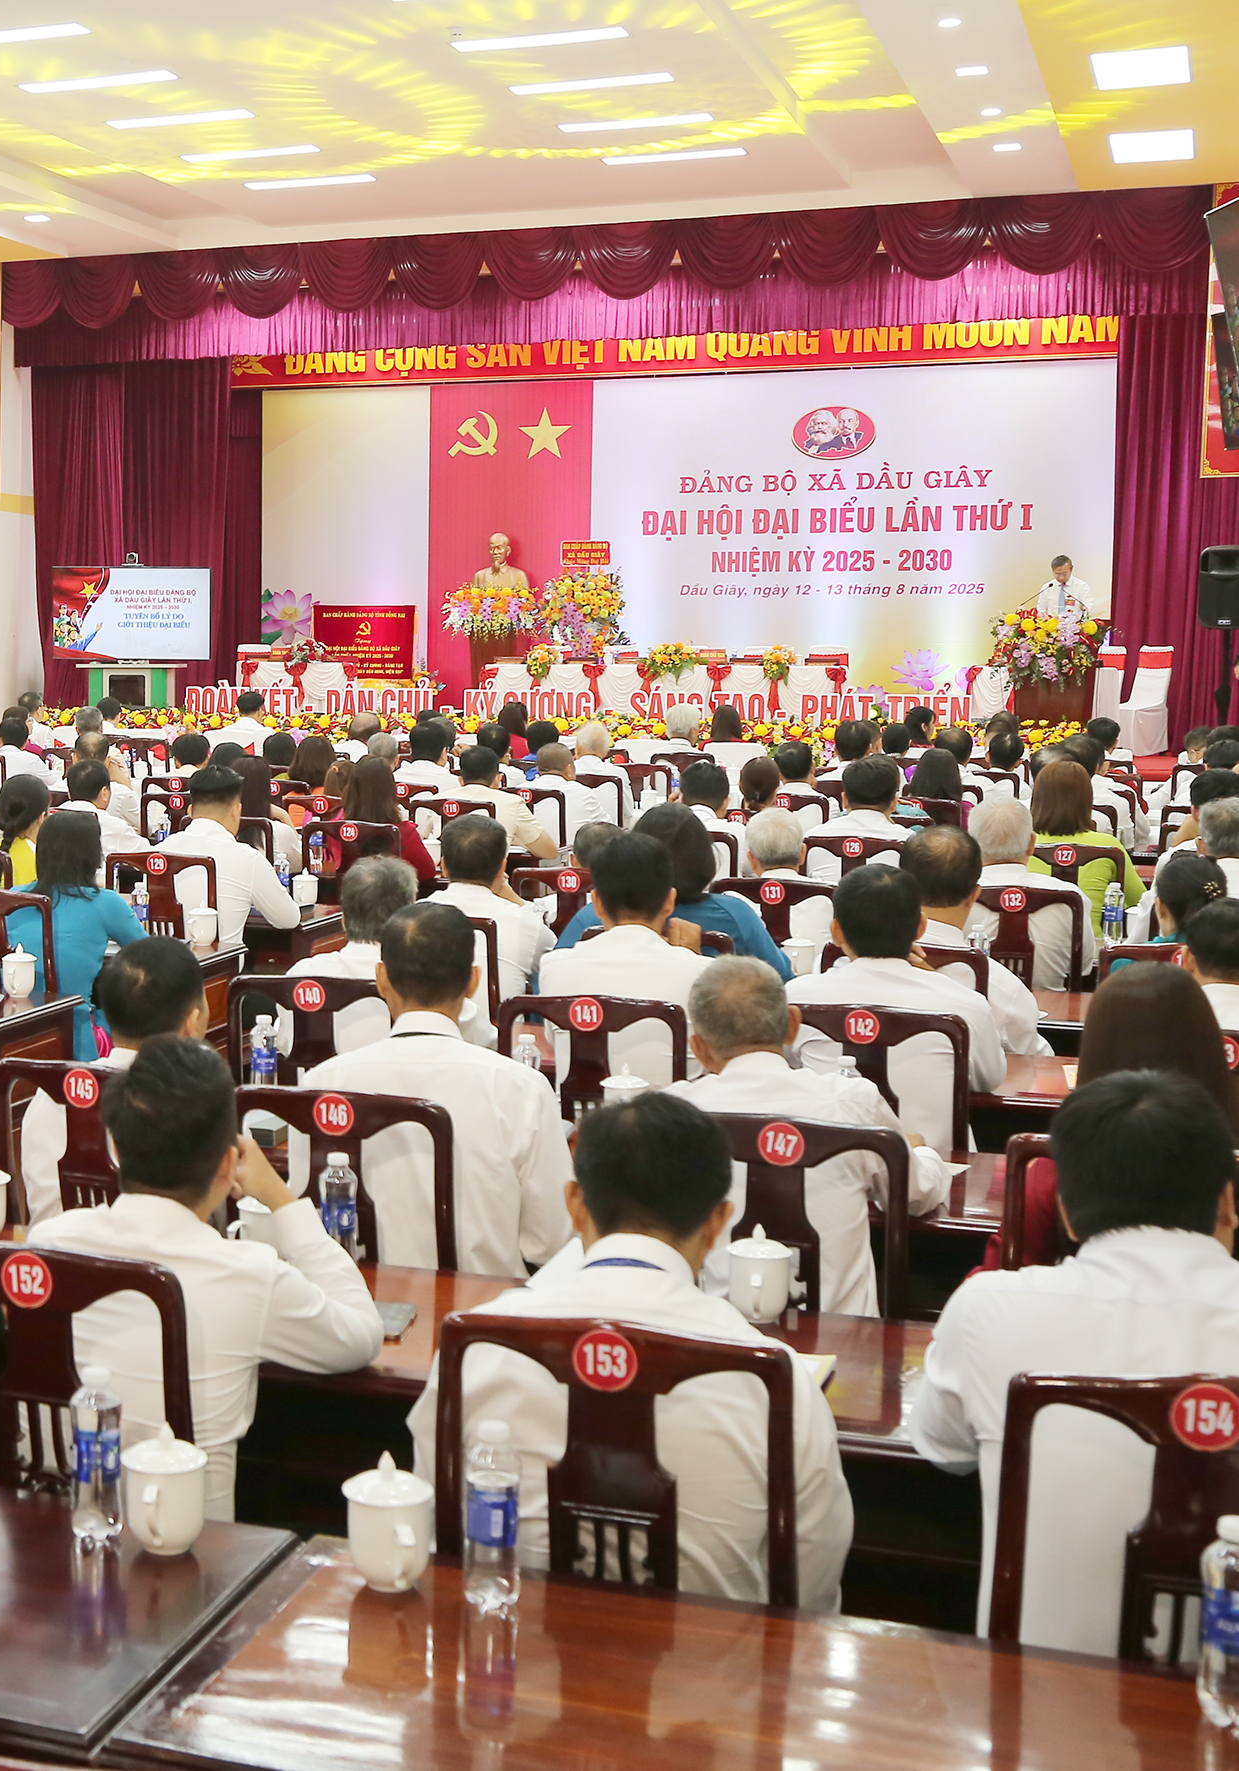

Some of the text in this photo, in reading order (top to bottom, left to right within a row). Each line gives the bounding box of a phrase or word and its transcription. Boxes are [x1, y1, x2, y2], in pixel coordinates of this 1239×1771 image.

[618, 334, 696, 362] NAM
[706, 330, 820, 362] QUANG
[832, 325, 912, 353] VINH
[679, 462, 993, 496] ĐẢNG BỘ XÃ DẦU GIÂY
[642, 496, 1034, 542] ĐẠI HỘI ĐẠI BIỂU LẦN THỨ I
[711, 546, 781, 577] NHIỆM
[788, 545, 814, 572] KỲ
[822, 549, 876, 572] 2025
[898, 548, 953, 572] 2030
[679, 583, 709, 597] Dầu
[713, 583, 747, 598] Giây,
[752, 584, 790, 599] ngày
[794, 583, 811, 596] 12
[827, 583, 843, 596] 13
[848, 582, 891, 599] tháng
[896, 583, 904, 596] 8
[909, 583, 942, 595] năm
[948, 583, 985, 595] 2025
[316, 801, 324, 809] 71
[777, 798, 789, 806] 115
[343, 827, 355, 836] 124
[846, 842, 859, 852] 126
[1058, 851, 1072, 860] 127
[561, 876, 576, 888] 130
[765, 887, 780, 898] 131
[1004, 894, 1022, 906] 132
[298, 987, 320, 1004] 140
[575, 1005, 597, 1022] 141
[849, 1018, 873, 1036] 142
[68, 1076, 94, 1100] 145
[319, 1102, 348, 1127] 146
[766, 1130, 799, 1158] 147
[8, 1264, 45, 1296] 152
[582, 1342, 627, 1379] 153
[1182, 1398, 1234, 1437] 154
